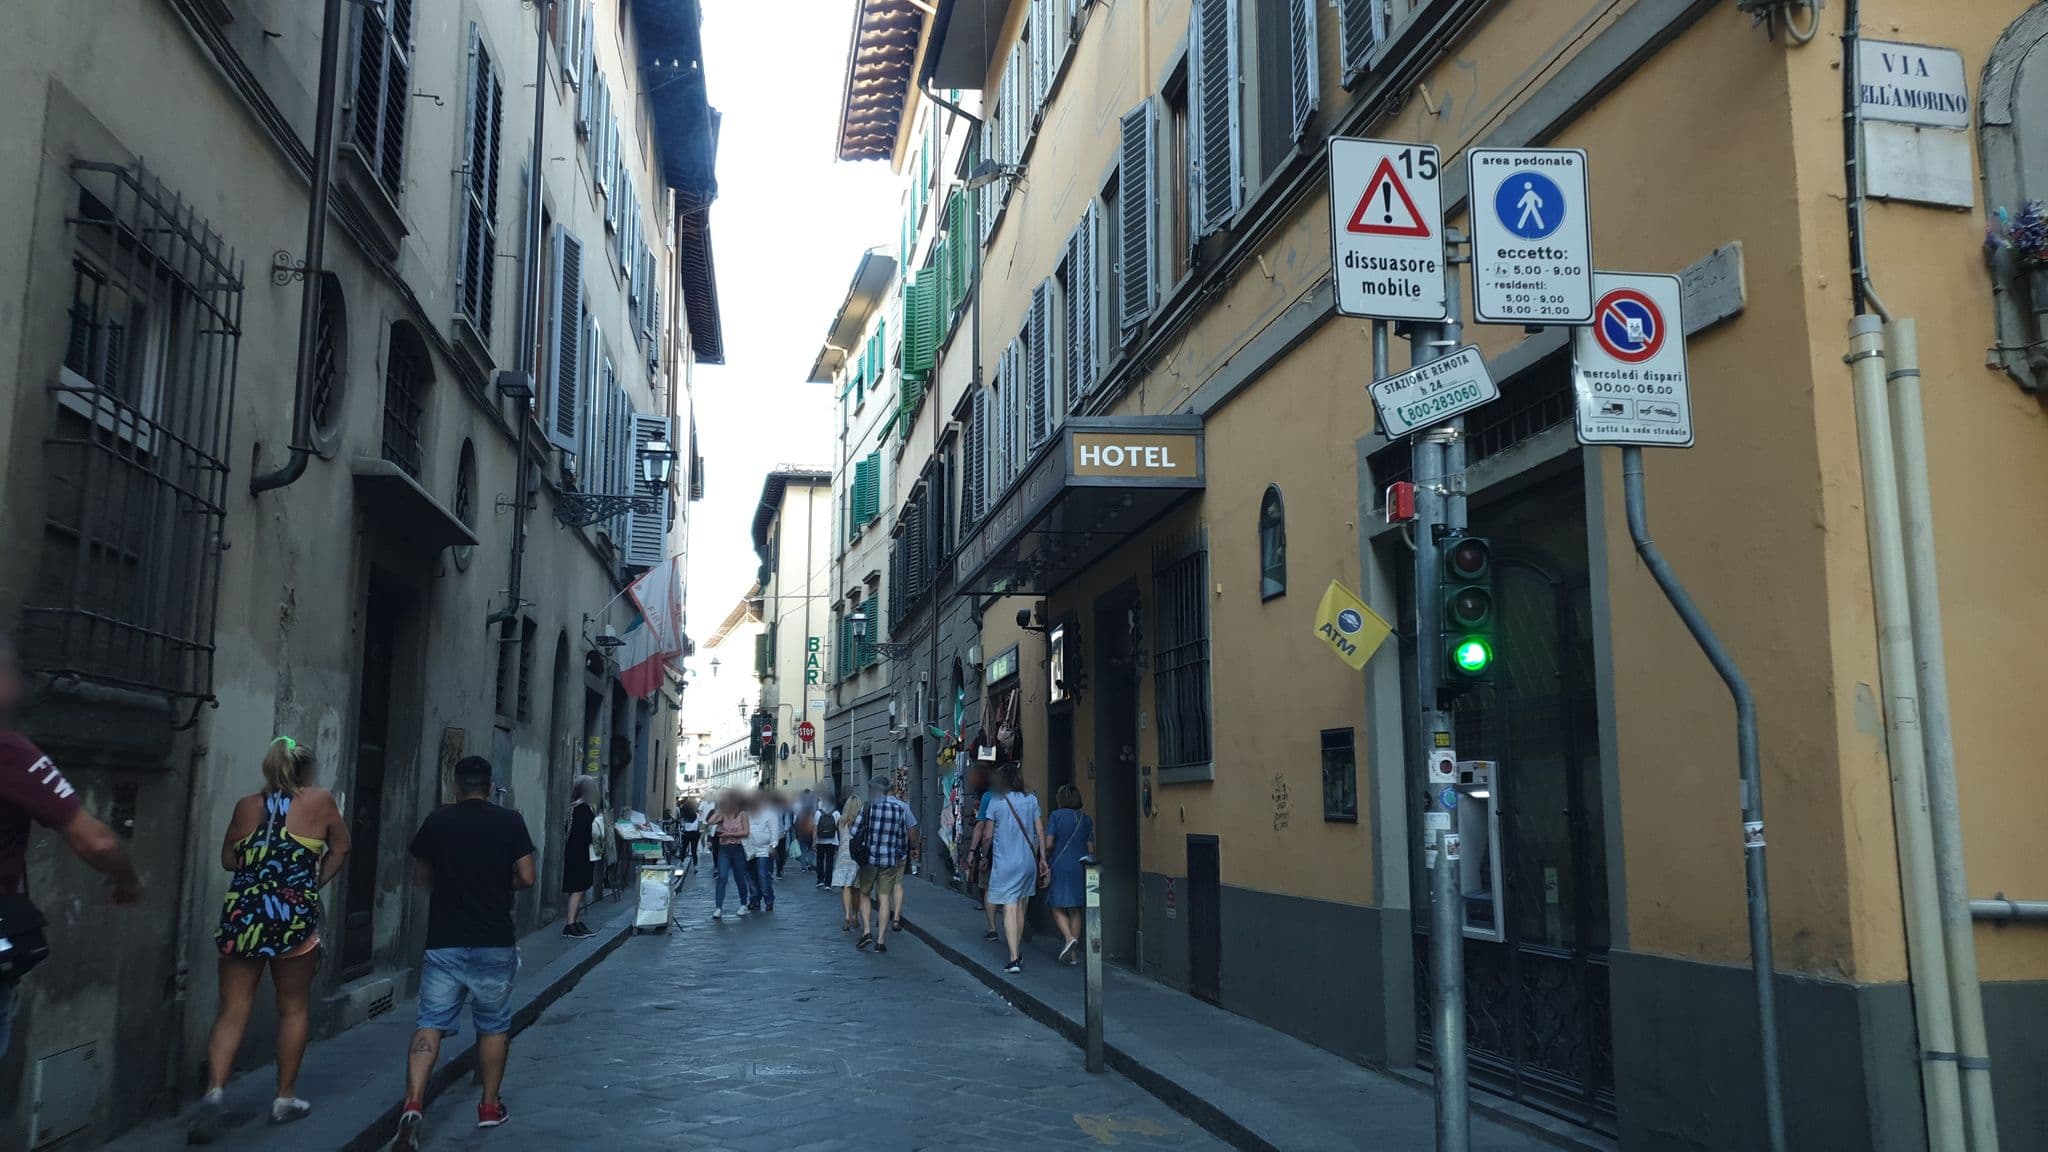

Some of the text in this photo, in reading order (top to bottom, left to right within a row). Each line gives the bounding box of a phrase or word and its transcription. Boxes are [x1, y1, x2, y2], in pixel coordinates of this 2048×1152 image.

[1882, 52, 1930, 78] VIA
[1861, 83, 1968, 114] ELL'AMORINO
[1398, 148, 1438, 181] 15
[1482, 156, 1573, 167] area pedonale
[1345, 250, 1436, 273] dissuasore
[1497, 247, 1568, 260] eccetto:
[1362, 277, 1421, 298] mobile
[1494, 280, 1547, 290] residenti:
[1384, 354, 1470, 394] STAZIONE REMOTA
[1643, 370, 1682, 383] dispari
[1420, 379, 1444, 396] h 24
[1407, 384, 1478, 421] 800-283060
[1621, 425, 1630, 433] la
[1080, 444, 1176, 468] HOTEL
[984, 505, 1018, 557] HOTEL
[1319, 622, 1357, 657] ATM
[807, 636, 820, 685] BAR
[799, 727, 814, 738] STOP
[27, 755, 75, 799] FTW
